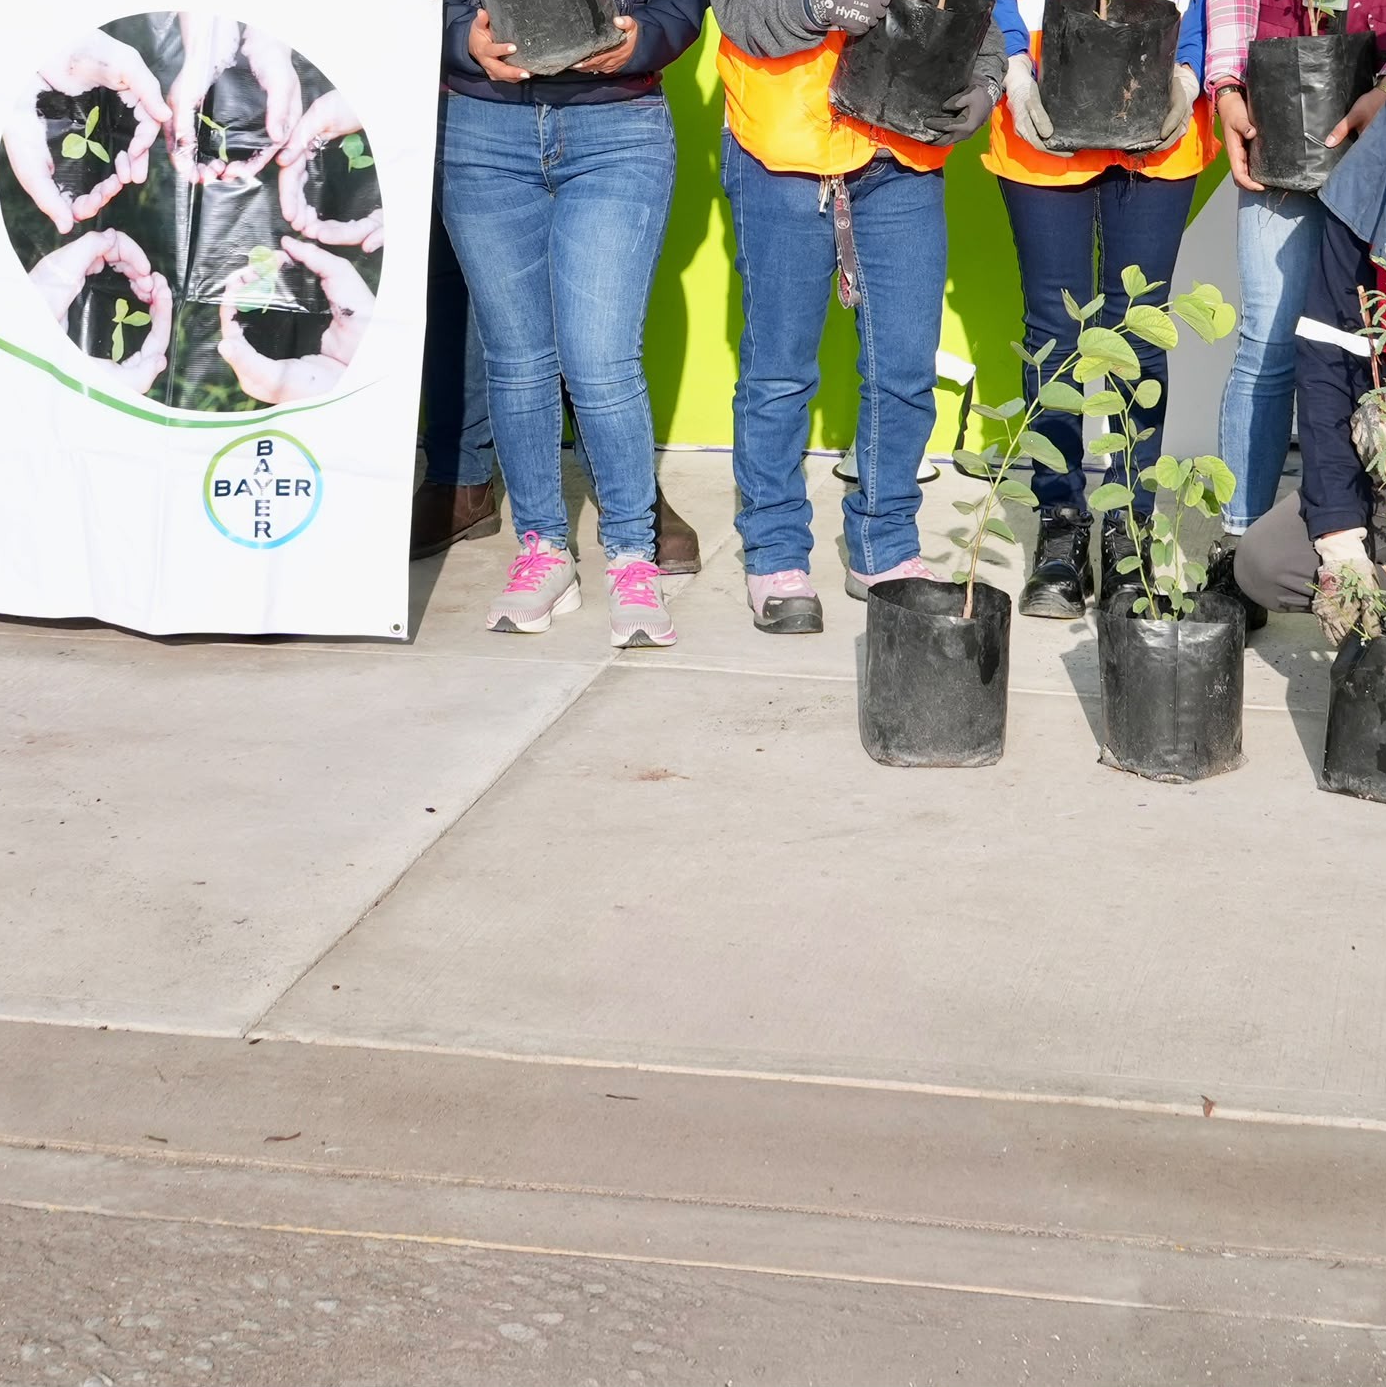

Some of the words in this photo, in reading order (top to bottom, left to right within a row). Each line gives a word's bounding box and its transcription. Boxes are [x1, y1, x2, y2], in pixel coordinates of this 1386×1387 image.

[835, 6, 871, 24] HyFlex
[214, 479, 311, 497] BAYER
[254, 440, 273, 538] BAYER
